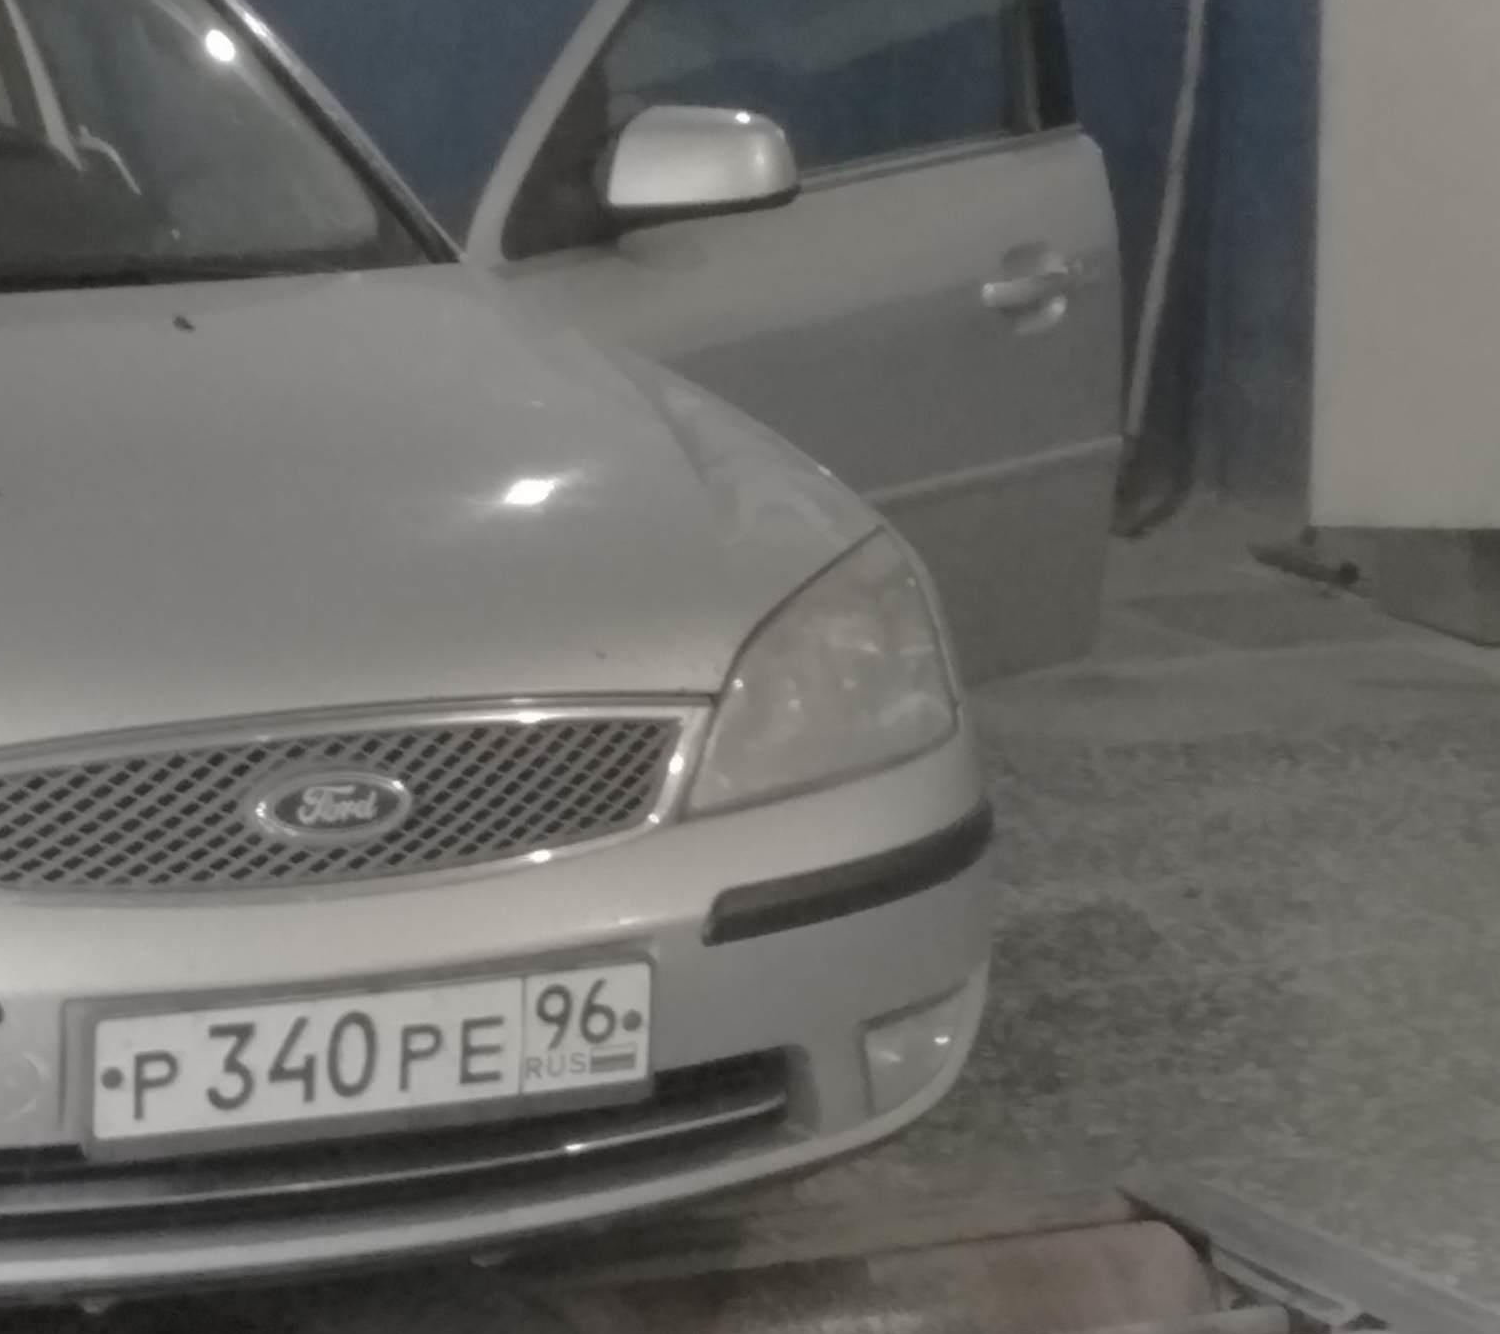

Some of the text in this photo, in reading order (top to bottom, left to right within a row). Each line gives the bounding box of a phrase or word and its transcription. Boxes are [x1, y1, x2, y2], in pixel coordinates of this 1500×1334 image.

[297, 784, 378, 825] Ford
[535, 978, 617, 1050] 96
[525, 1054, 587, 1082] RUS
